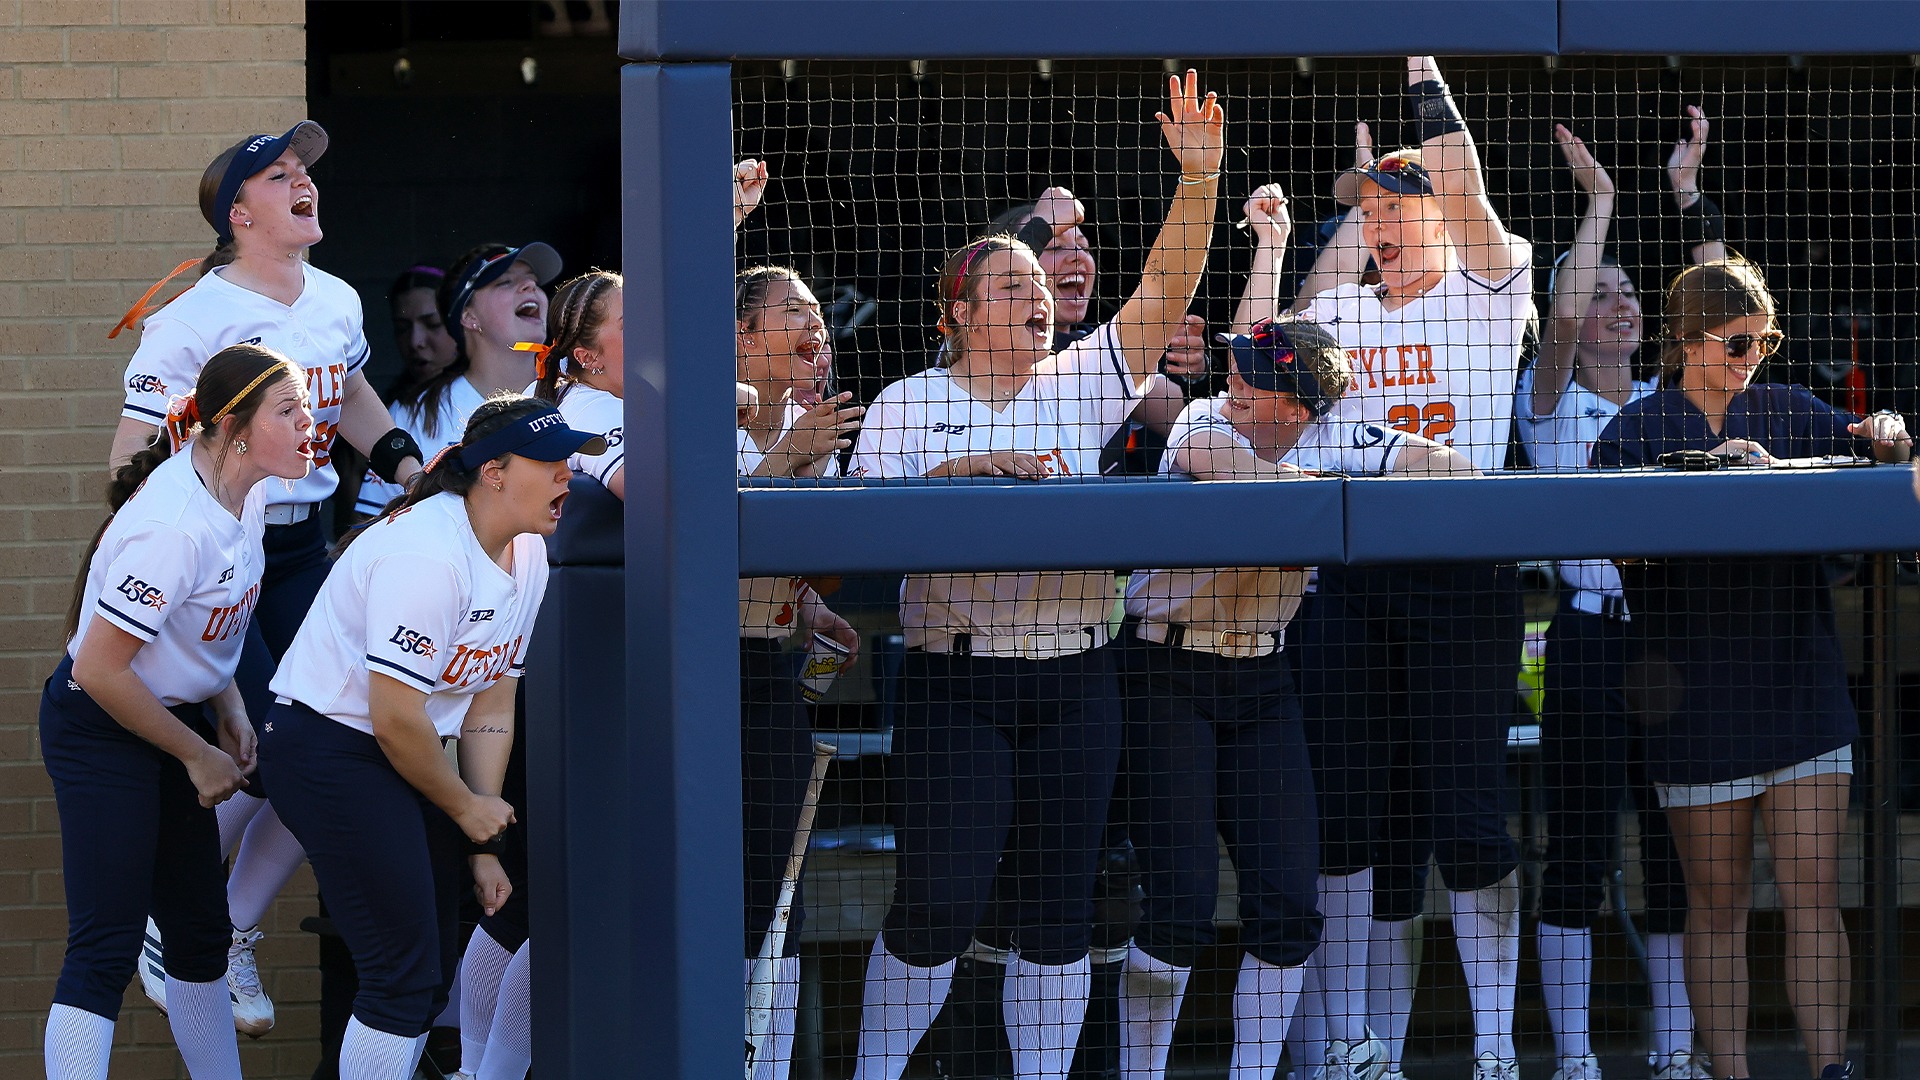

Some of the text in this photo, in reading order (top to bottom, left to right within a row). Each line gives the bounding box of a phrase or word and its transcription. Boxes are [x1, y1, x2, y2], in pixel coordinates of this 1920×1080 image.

[1346, 345, 1437, 391] TYLER
[1388, 401, 1456, 446] 22
[117, 574, 162, 606] LSC
[389, 625, 432, 655] LSC
